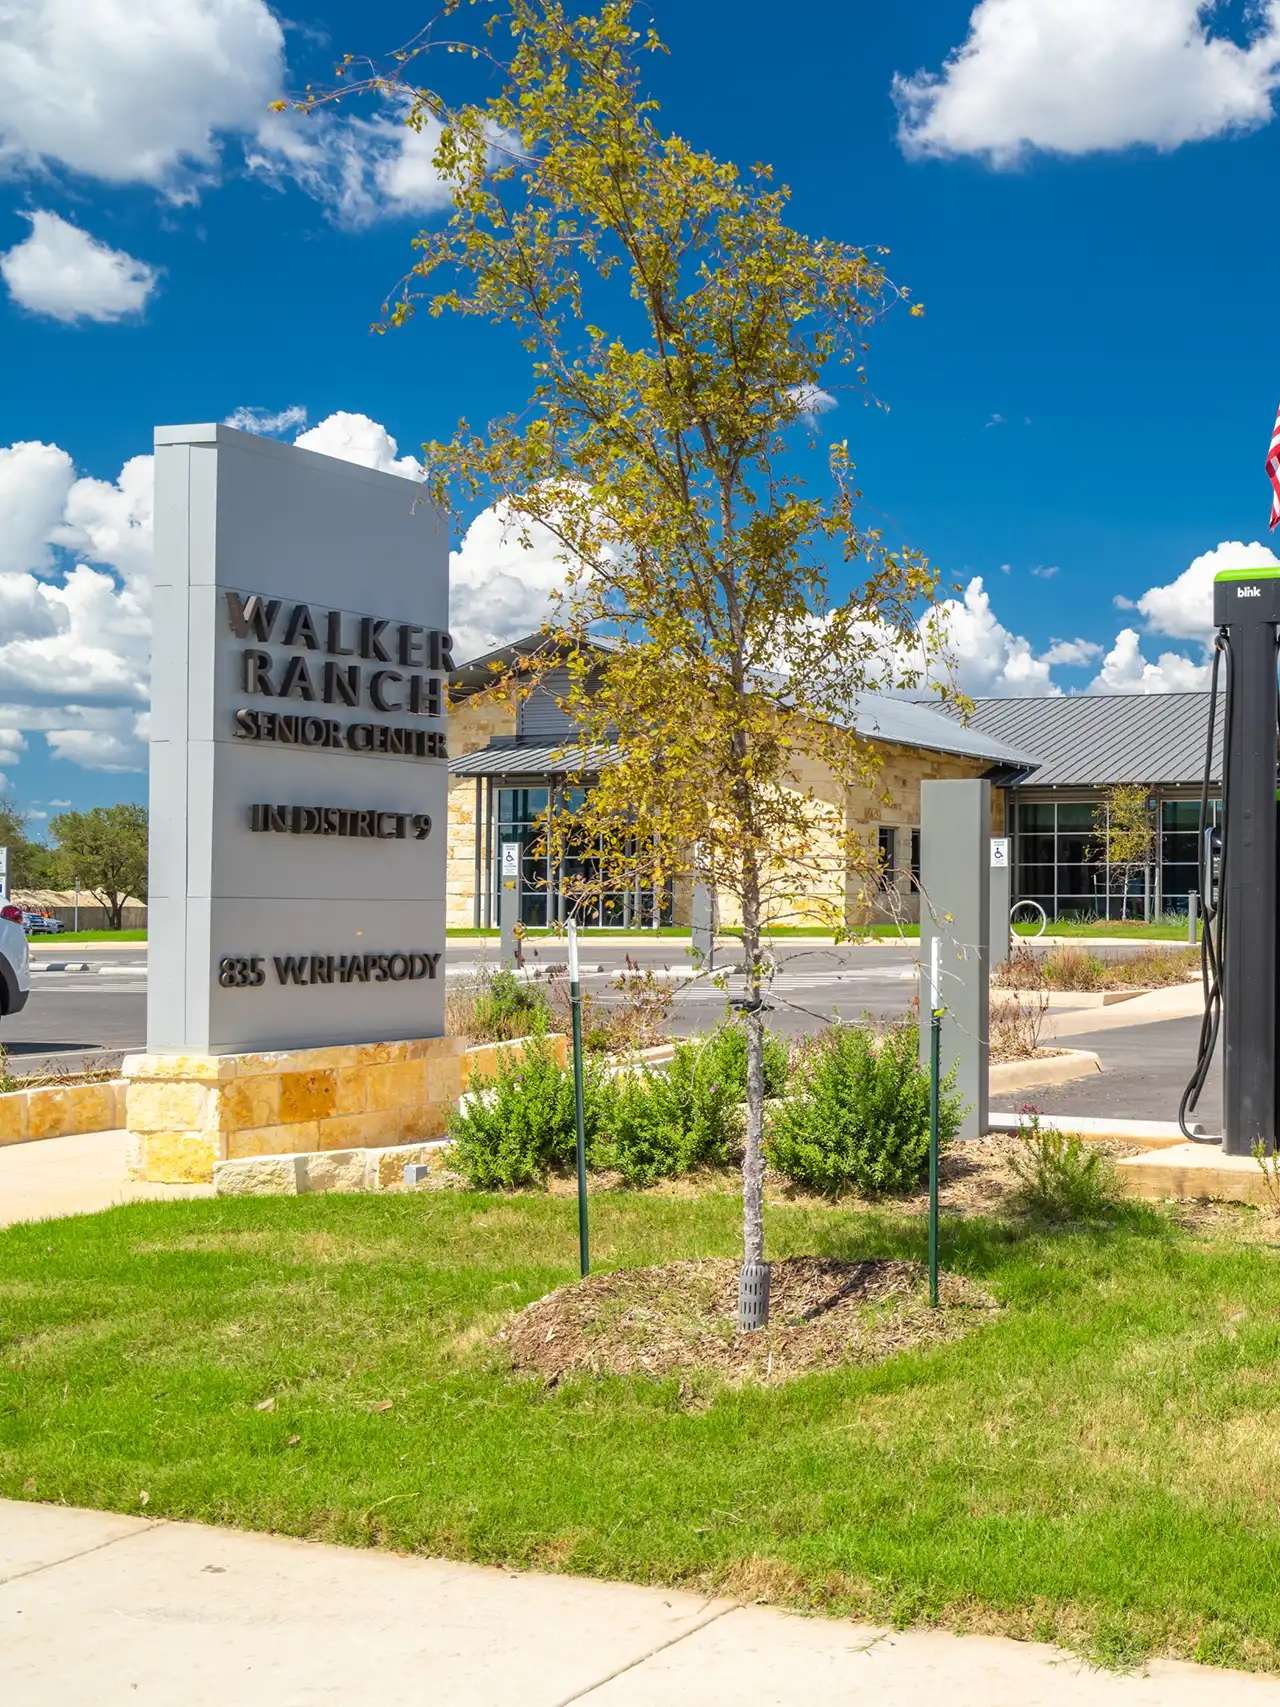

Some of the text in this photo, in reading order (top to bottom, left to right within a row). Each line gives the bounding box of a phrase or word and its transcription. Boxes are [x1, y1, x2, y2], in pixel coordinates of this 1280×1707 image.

[1237, 586, 1261, 598] blink
[225, 592, 455, 671] WALKER
[243, 648, 442, 717] RANCH
[233, 708, 449, 758] SENIOR CENTER
[248, 803, 432, 840] IN DISTRICT 9
[219, 956, 266, 988] 835
[309, 952, 442, 985] RHAPSODY
